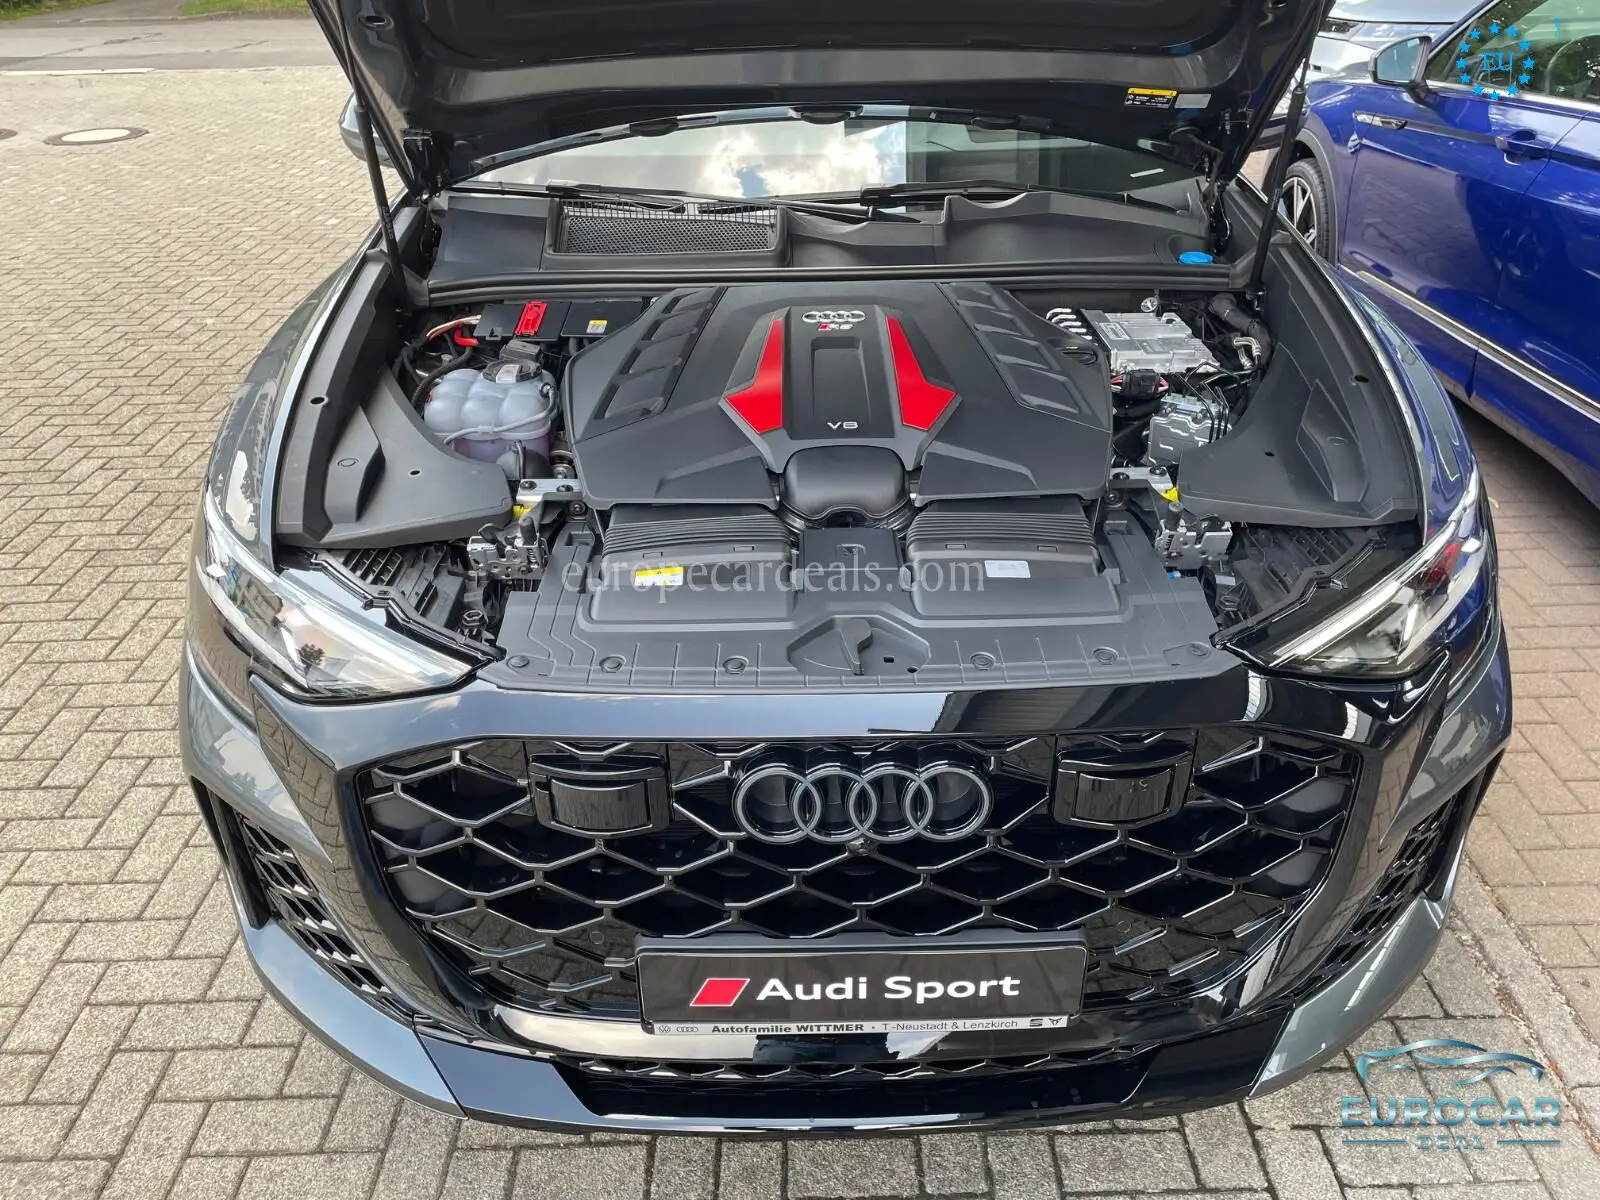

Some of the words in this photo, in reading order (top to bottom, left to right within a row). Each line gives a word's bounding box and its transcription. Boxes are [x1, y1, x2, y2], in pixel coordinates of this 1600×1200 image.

[827, 421, 858, 429] V8
[756, 976, 867, 1000] Audi
[884, 976, 1021, 1004] Sport
[711, 1025, 792, 1033] Autofamilie
[796, 1023, 864, 1032] WITTMER
[951, 1021, 959, 1030] &
[963, 1020, 1018, 1029] Lenzkirch
